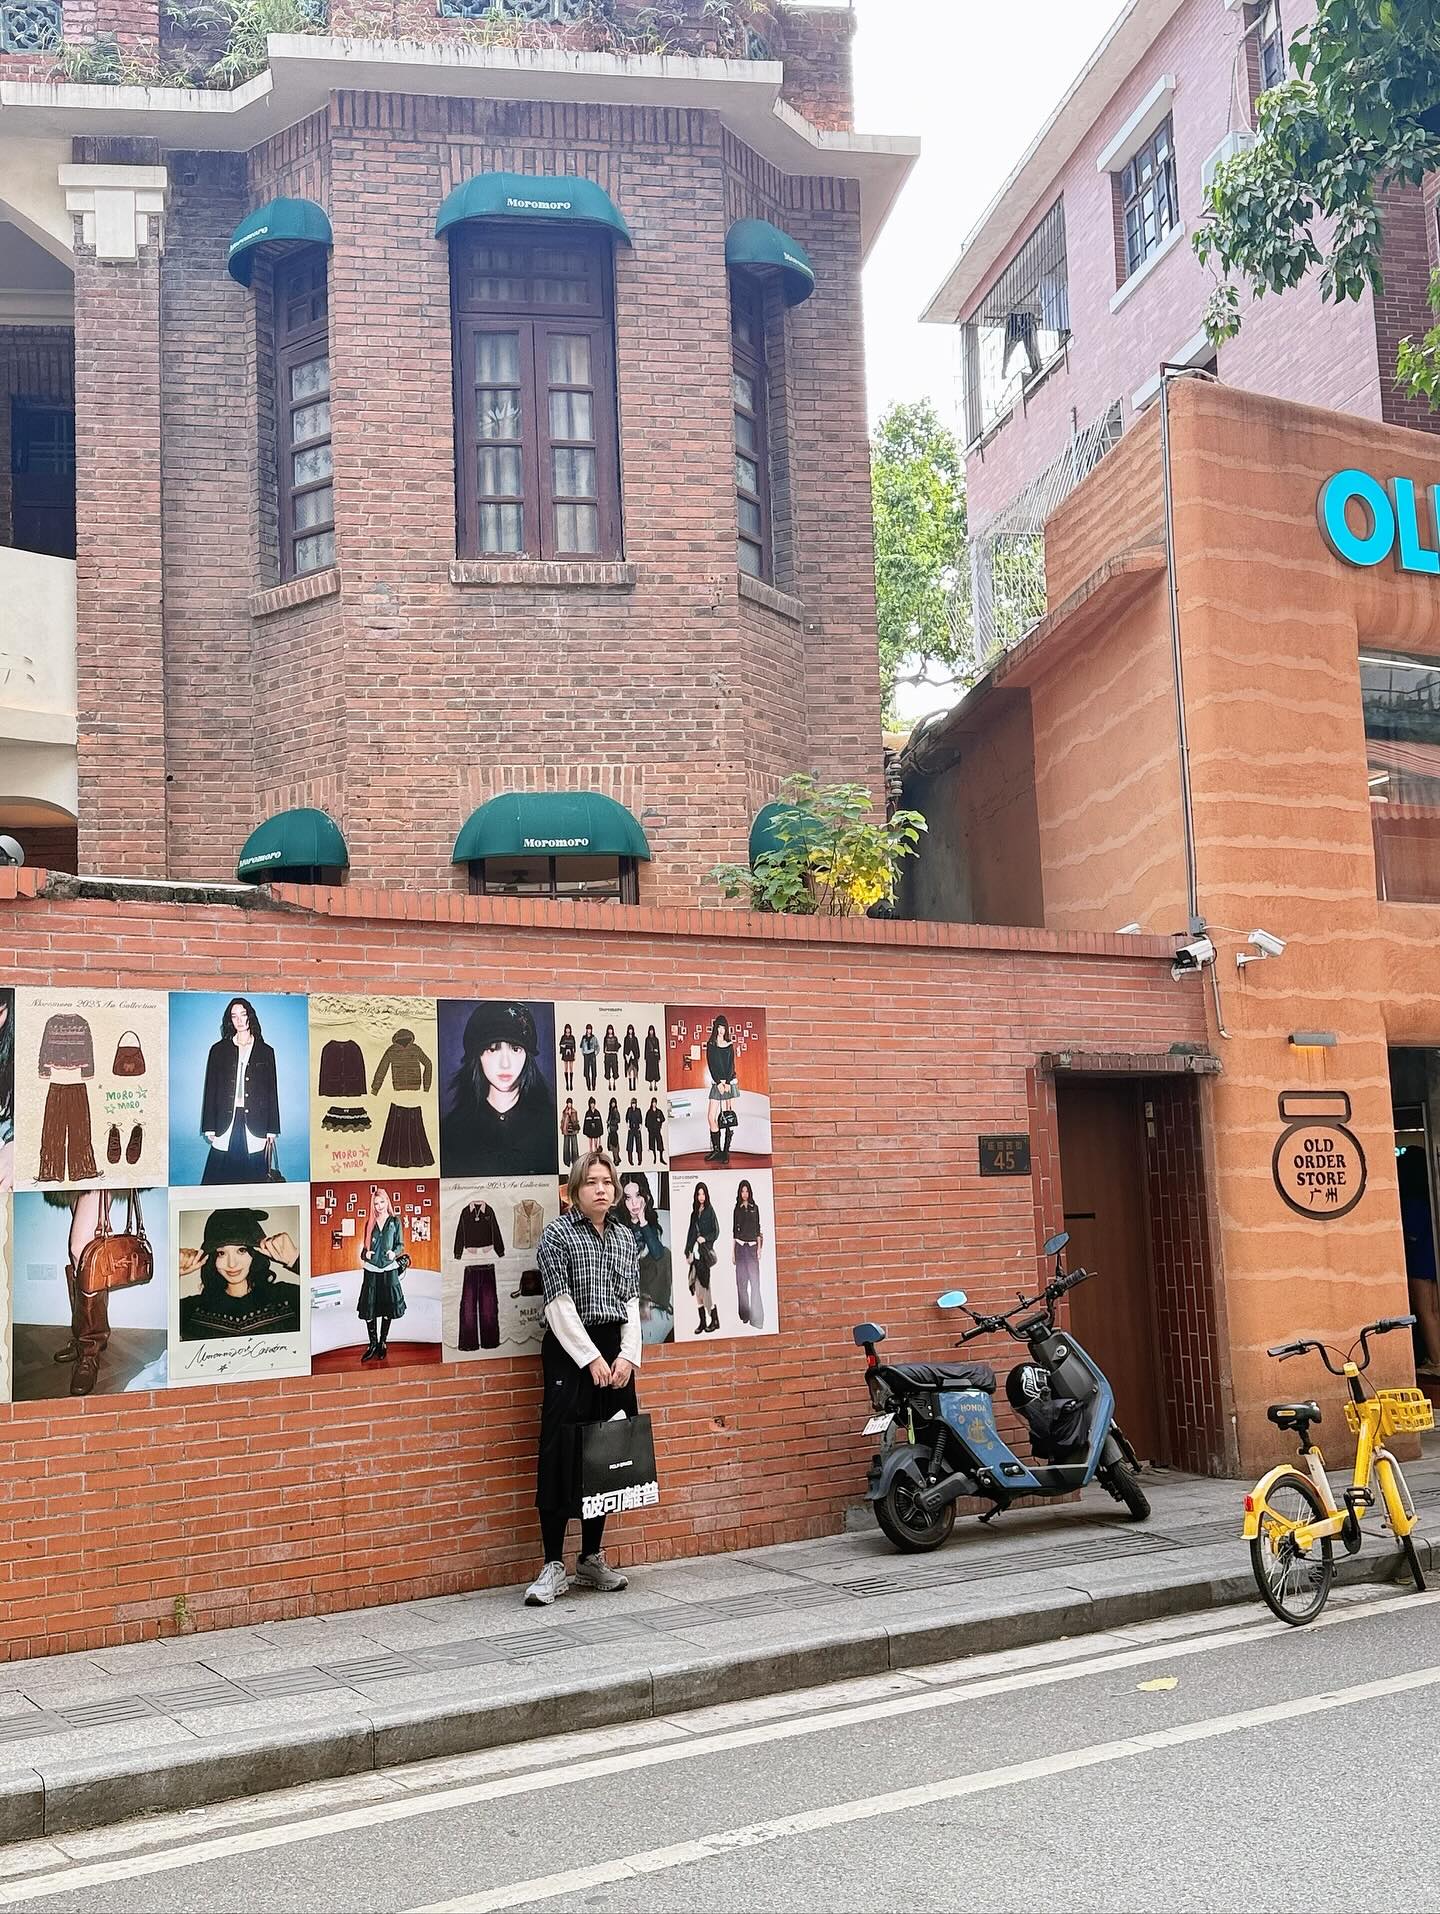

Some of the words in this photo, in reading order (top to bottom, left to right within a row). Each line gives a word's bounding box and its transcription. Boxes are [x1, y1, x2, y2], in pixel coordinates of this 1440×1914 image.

[507, 198, 571, 210] Moromoro
[1316, 468, 1440, 577] OL
[523, 838, 589, 848] Moromoro
[106, 1090, 134, 1101] MORO
[118, 1100, 140, 1110] MORO
[1303, 1138, 1334, 1153] OLD
[332, 1150, 357, 1161] MORO
[993, 1151, 1016, 1170] 45
[1293, 1154, 1347, 1169] ORDER
[1296, 1171, 1347, 1186] STORE
[1308, 1187, 1339, 1206] 广州
[960, 1403, 987, 1412] HONDA
